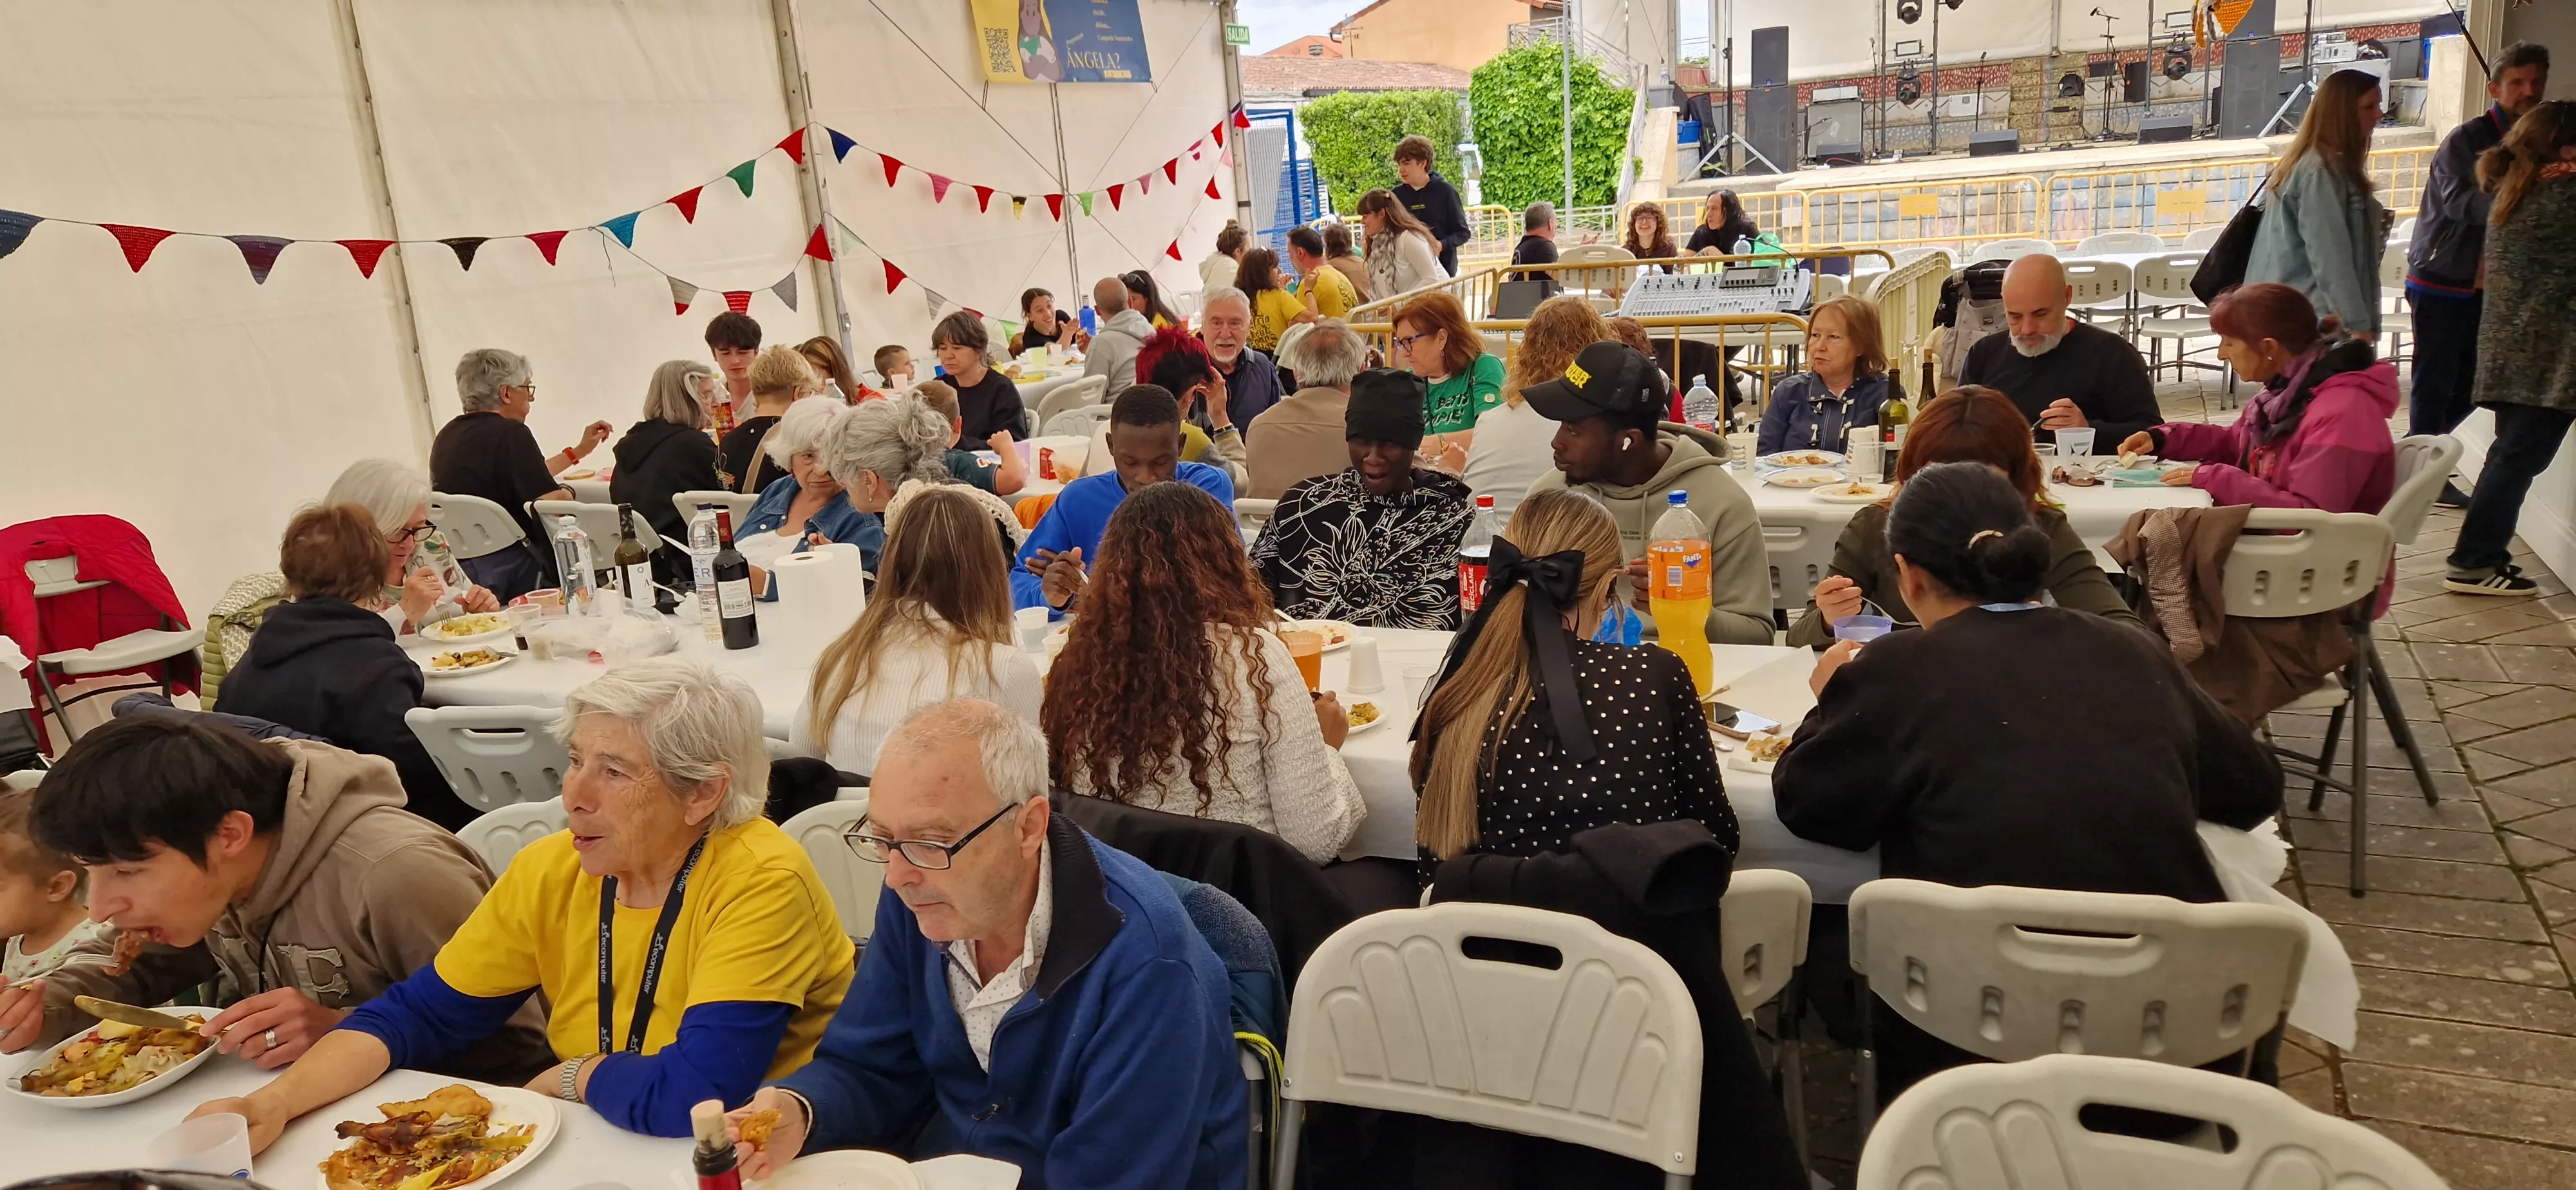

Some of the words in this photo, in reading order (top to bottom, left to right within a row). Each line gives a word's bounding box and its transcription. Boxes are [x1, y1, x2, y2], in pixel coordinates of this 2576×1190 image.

[1227, 27, 1249, 42] SALIDA
[1067, 48, 1121, 70] ÁNGELA?
[676, 849, 701, 893] ecomputer
[643, 947, 659, 994] ecomputer
